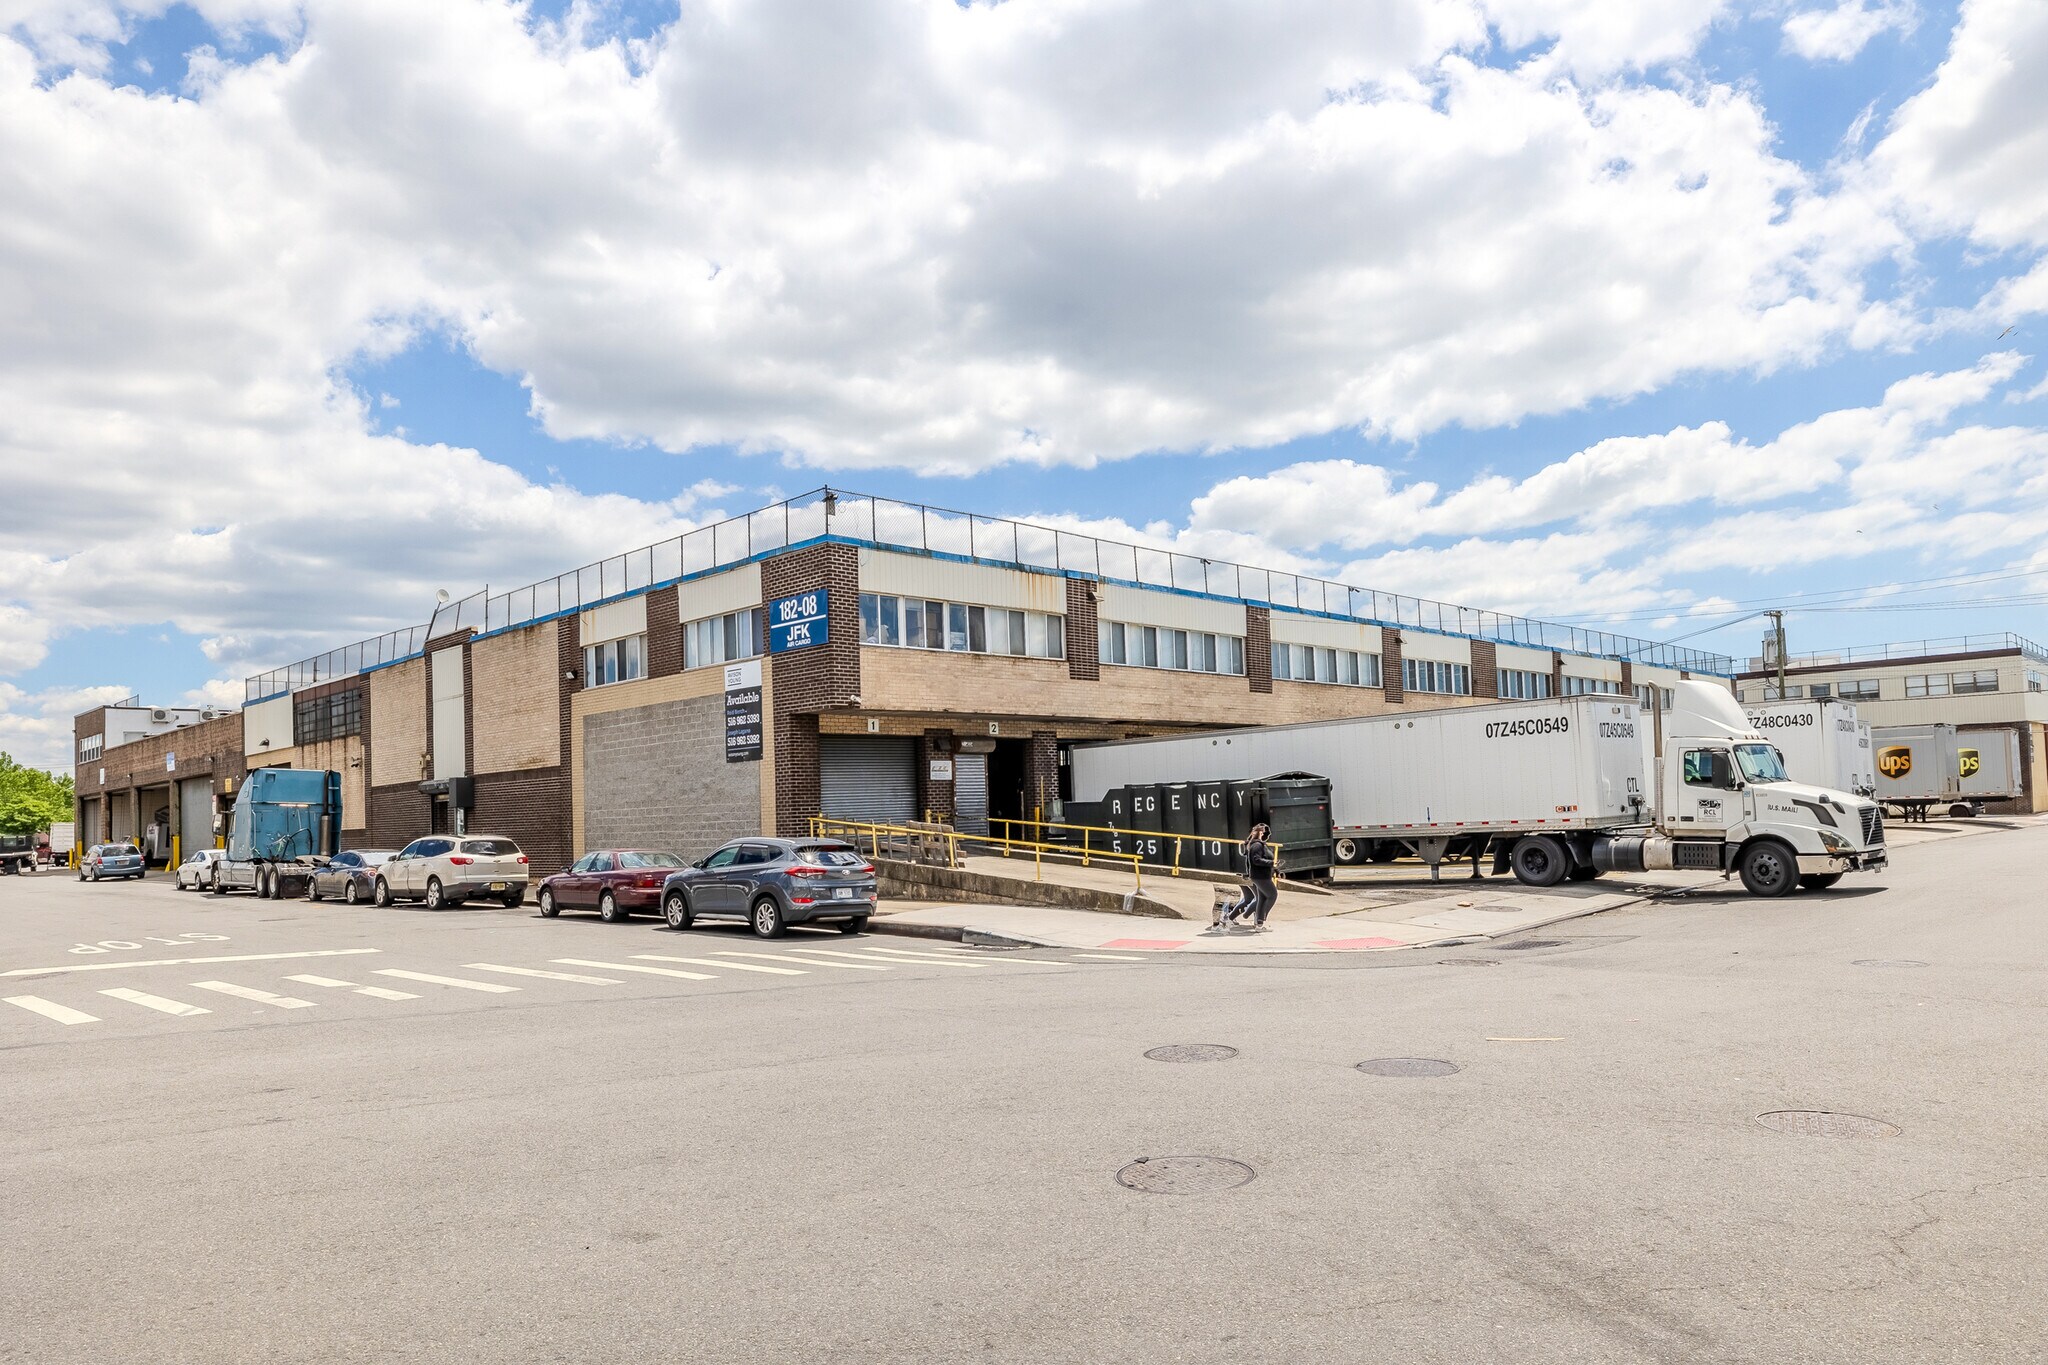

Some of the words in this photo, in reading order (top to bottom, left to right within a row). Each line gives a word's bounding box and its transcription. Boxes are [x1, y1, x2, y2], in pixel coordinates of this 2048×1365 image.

[779, 595, 817, 621] 182-08
[787, 623, 810, 641] JFK
[794, 638, 812, 646] CARGO
[726, 691, 760, 706] Available
[871, 721, 875, 730] 1
[991, 723, 997, 733] 2
[1486, 716, 1569, 739] 07Z45C0549
[1747, 713, 1813, 729] 7Z48C0430
[1599, 722, 1635, 739] 07Z45C0549
[1879, 755, 1910, 776] ups
[1959, 757, 1979, 776] ps
[1626, 777, 1640, 793] CTL
[1555, 805, 1578, 813] CTL
[67, 932, 231, 955] STOP
